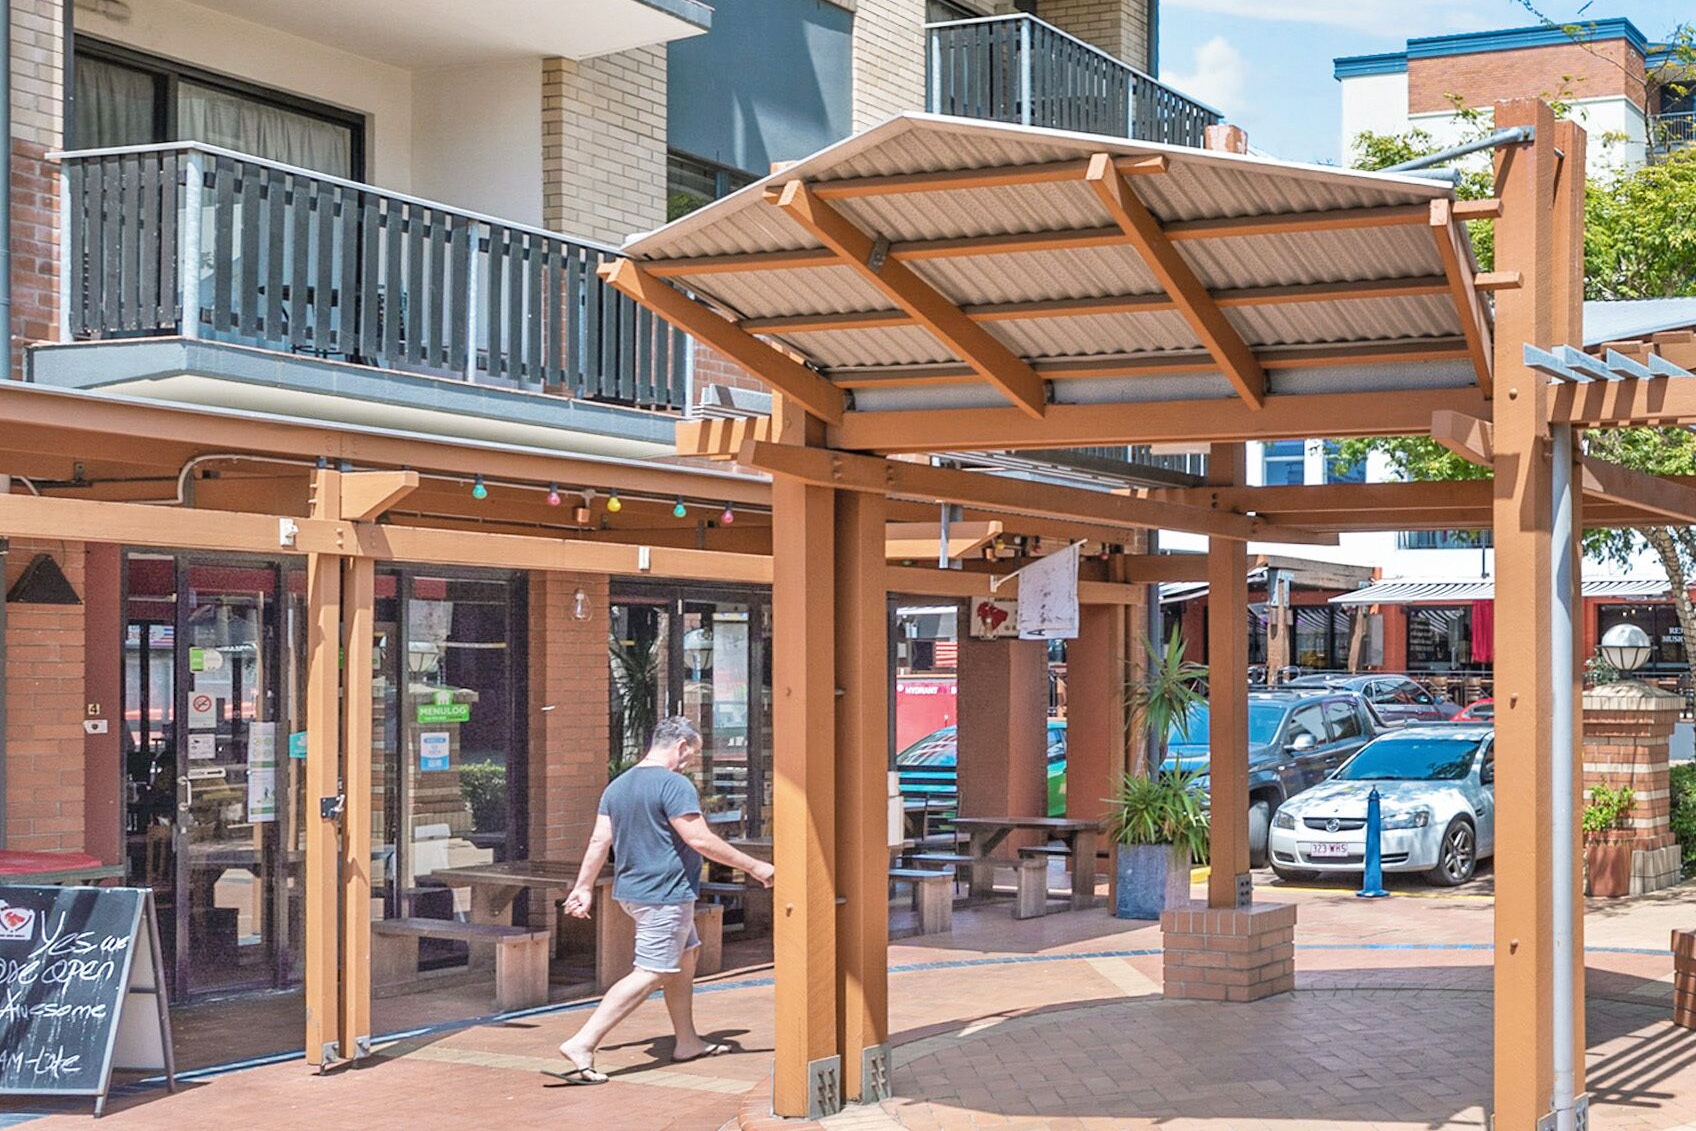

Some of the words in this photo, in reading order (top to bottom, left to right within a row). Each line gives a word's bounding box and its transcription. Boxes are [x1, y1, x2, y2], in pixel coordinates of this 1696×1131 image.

[904, 685, 939, 695] HYDRANT
[419, 707, 466, 716] MENULOG
[28, 911, 97, 958] Yes
